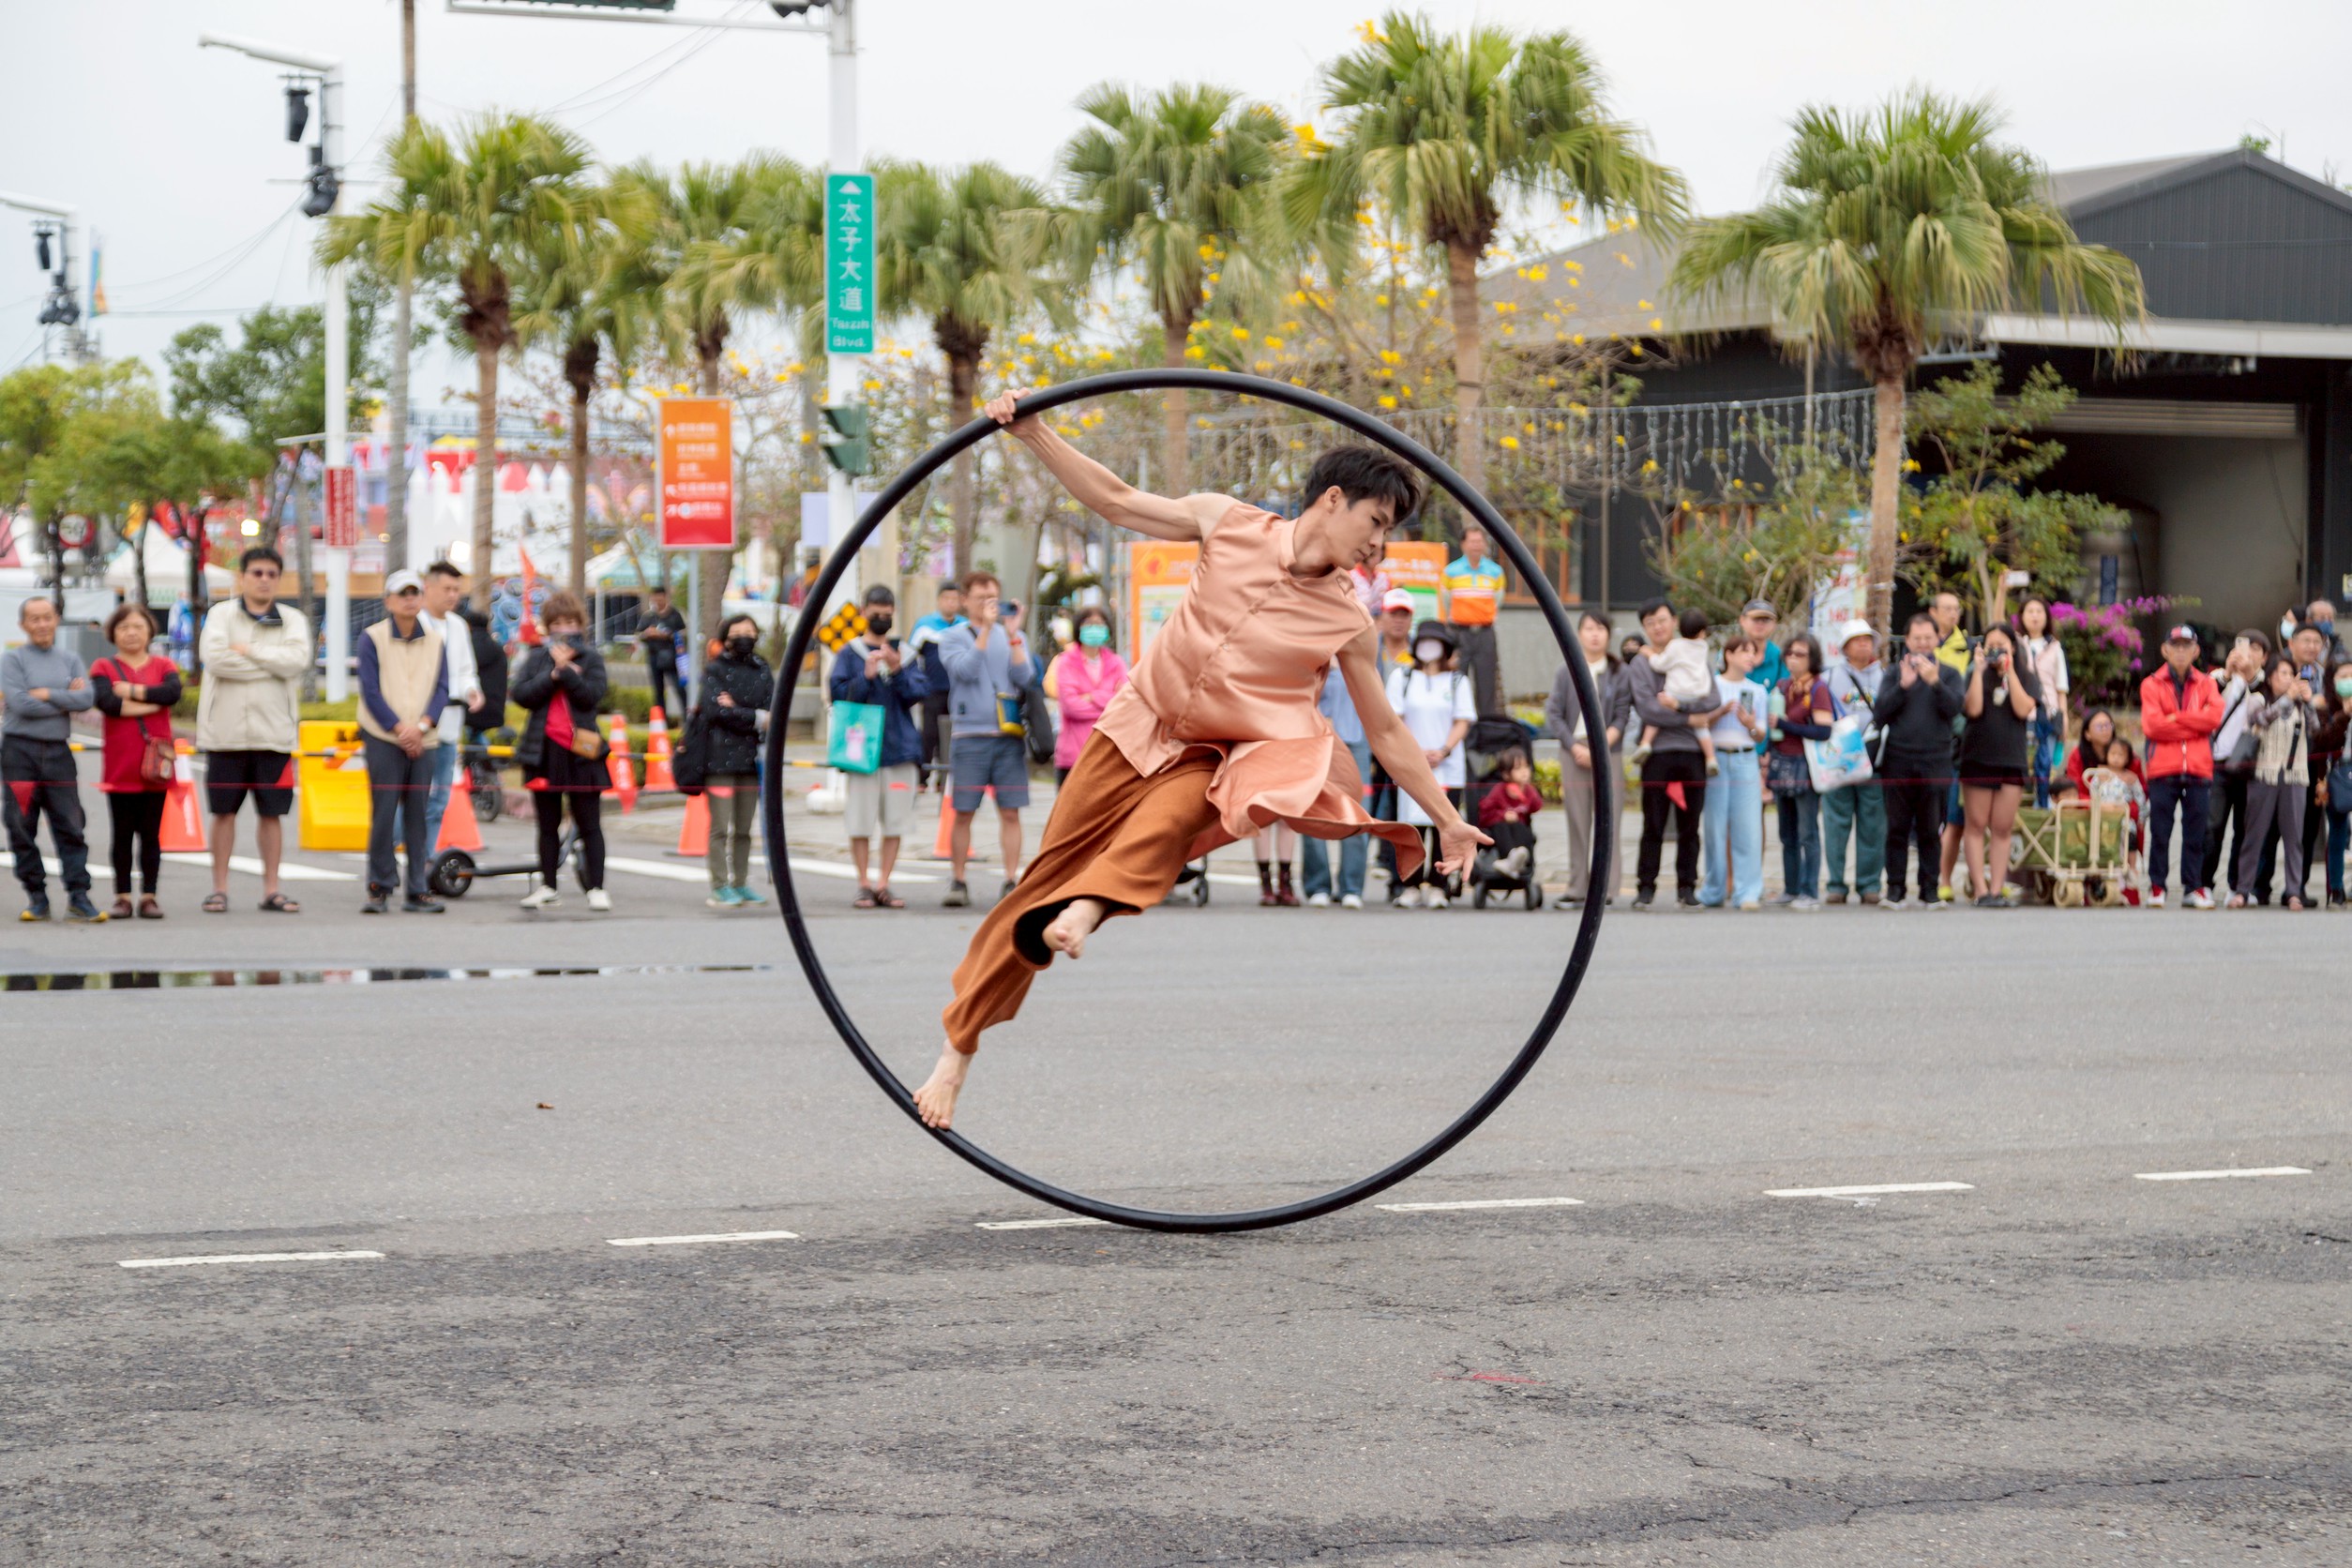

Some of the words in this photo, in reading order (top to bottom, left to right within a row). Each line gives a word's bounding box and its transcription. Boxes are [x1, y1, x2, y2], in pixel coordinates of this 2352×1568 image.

[837, 198, 863, 311] 太子大道
[832, 335, 867, 347] Blvd.
